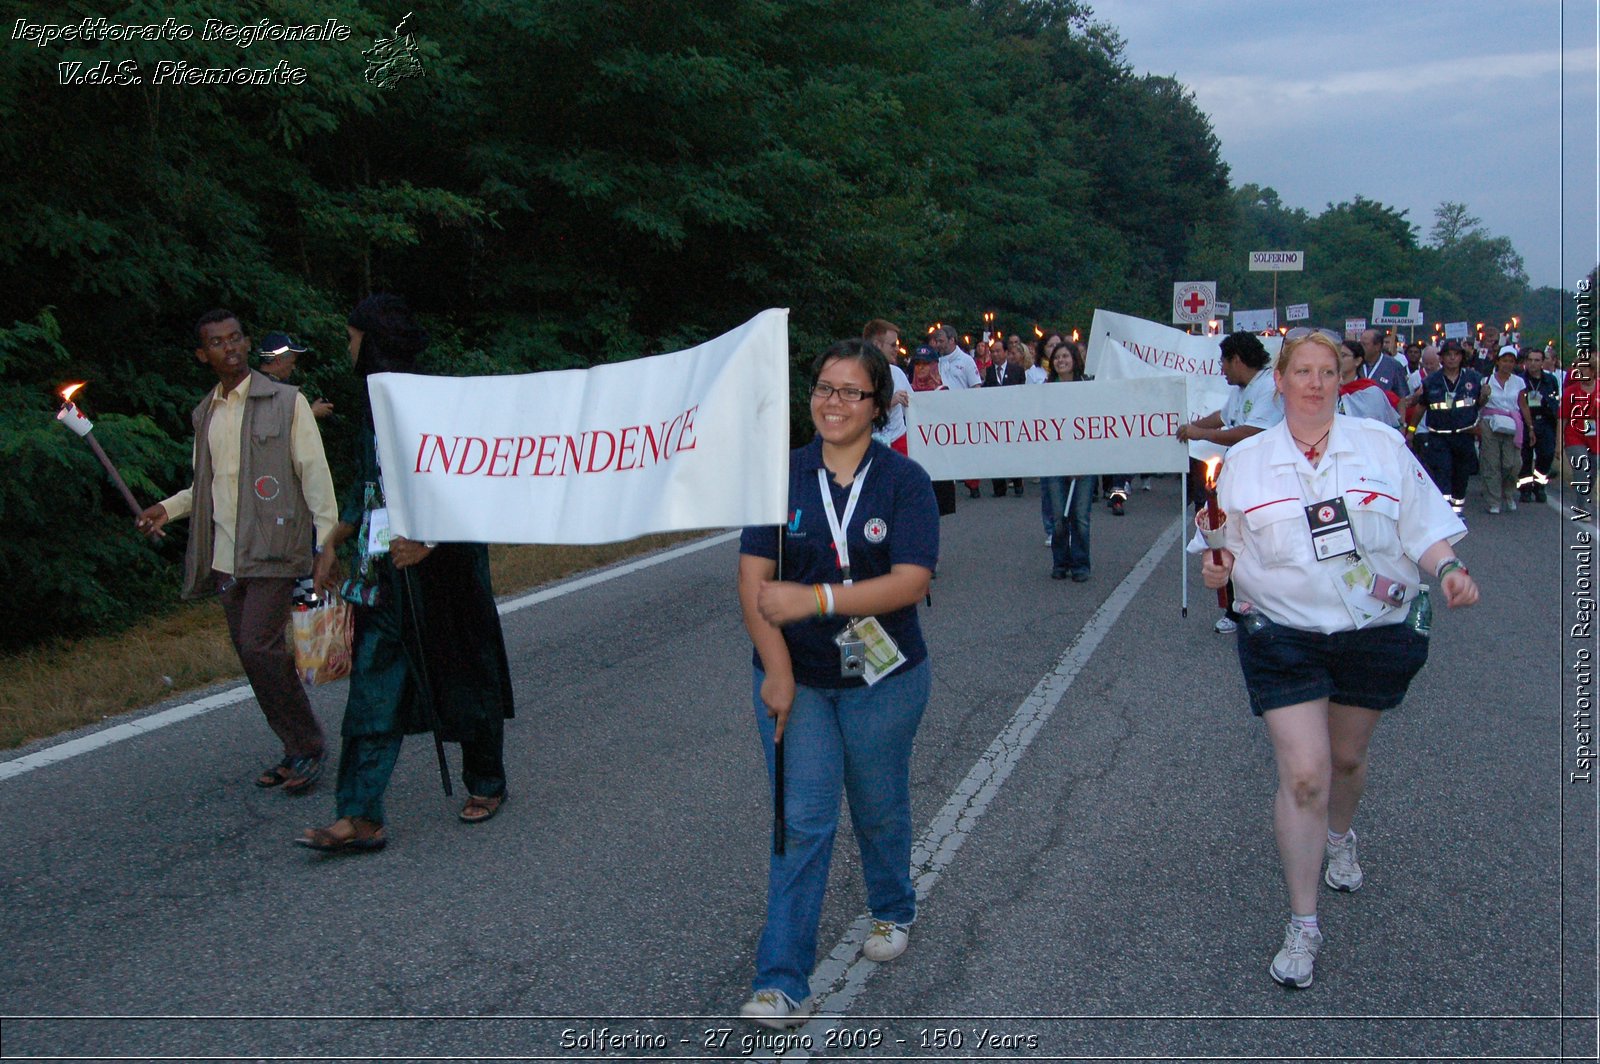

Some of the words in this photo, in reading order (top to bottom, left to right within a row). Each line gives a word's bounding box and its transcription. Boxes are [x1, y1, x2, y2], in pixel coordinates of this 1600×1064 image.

[1254, 252, 1298, 263] SOLFERINO
[414, 404, 700, 477] INDEPENDENCE
[917, 416, 1067, 448] VOLUNTARY
[1073, 411, 1180, 441] SERVICE
